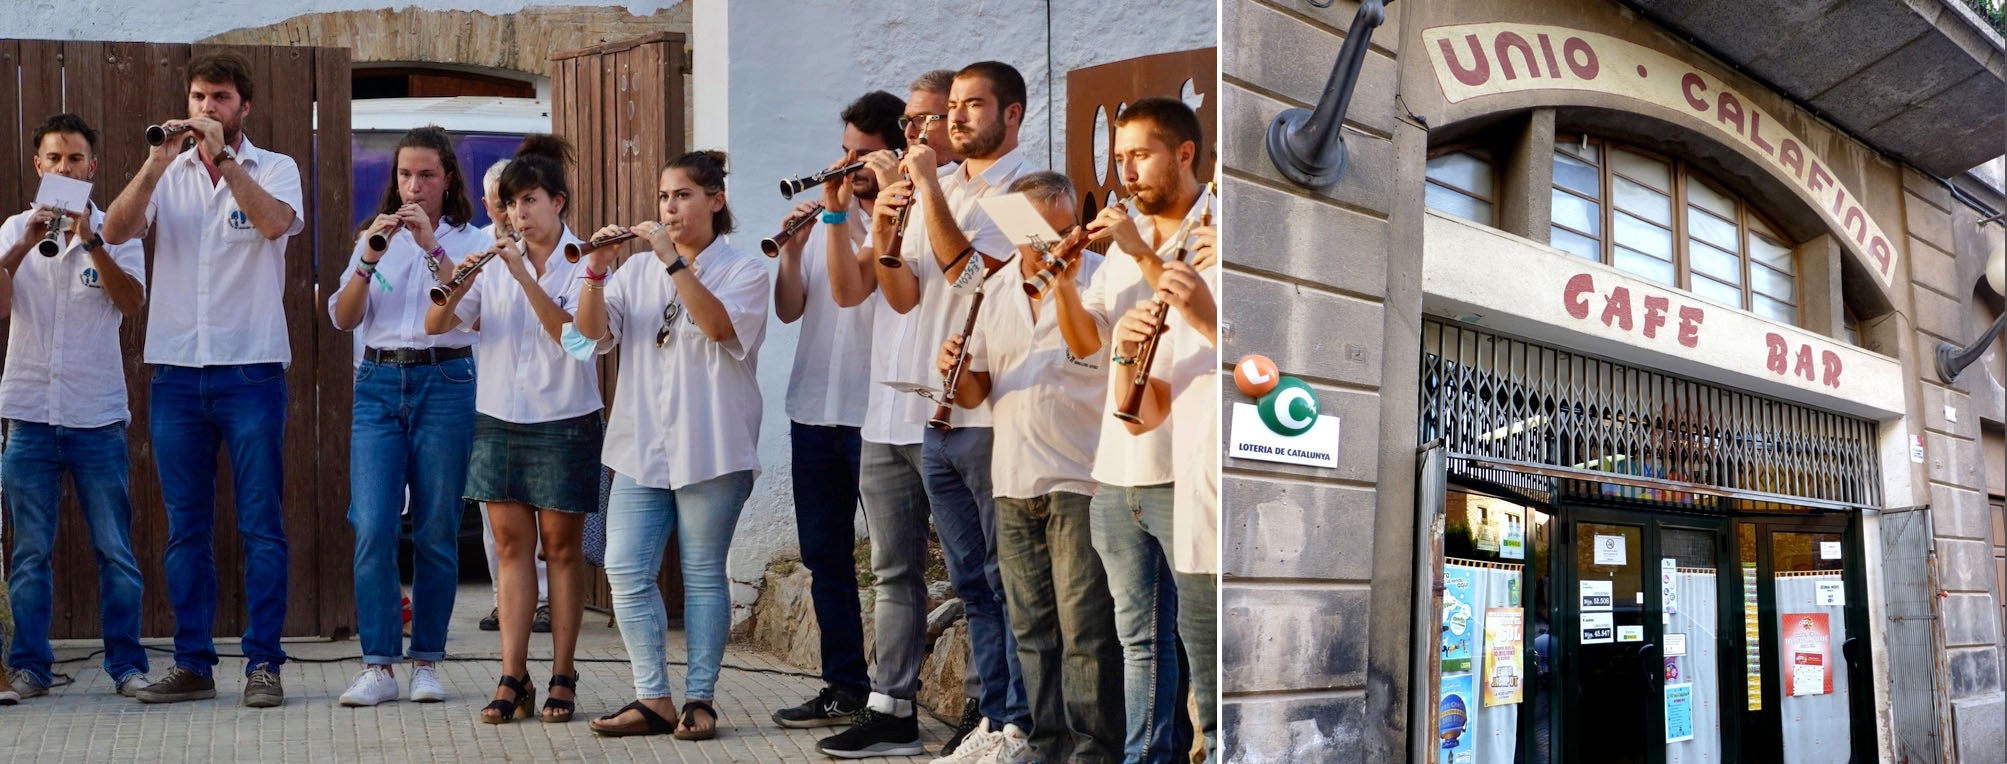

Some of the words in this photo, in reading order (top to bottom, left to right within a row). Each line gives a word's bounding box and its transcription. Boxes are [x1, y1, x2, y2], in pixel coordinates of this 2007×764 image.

[1437, 31, 1600, 86] UNIO
[1681, 72, 1891, 276] CALAFINA
[1563, 273, 1704, 348] CAFE
[1765, 332, 1843, 389] BAR
[1239, 442, 1273, 454] LOTERIA
[1275, 447, 1285, 456] DE
[1287, 448, 1331, 461] CATALUNYA
